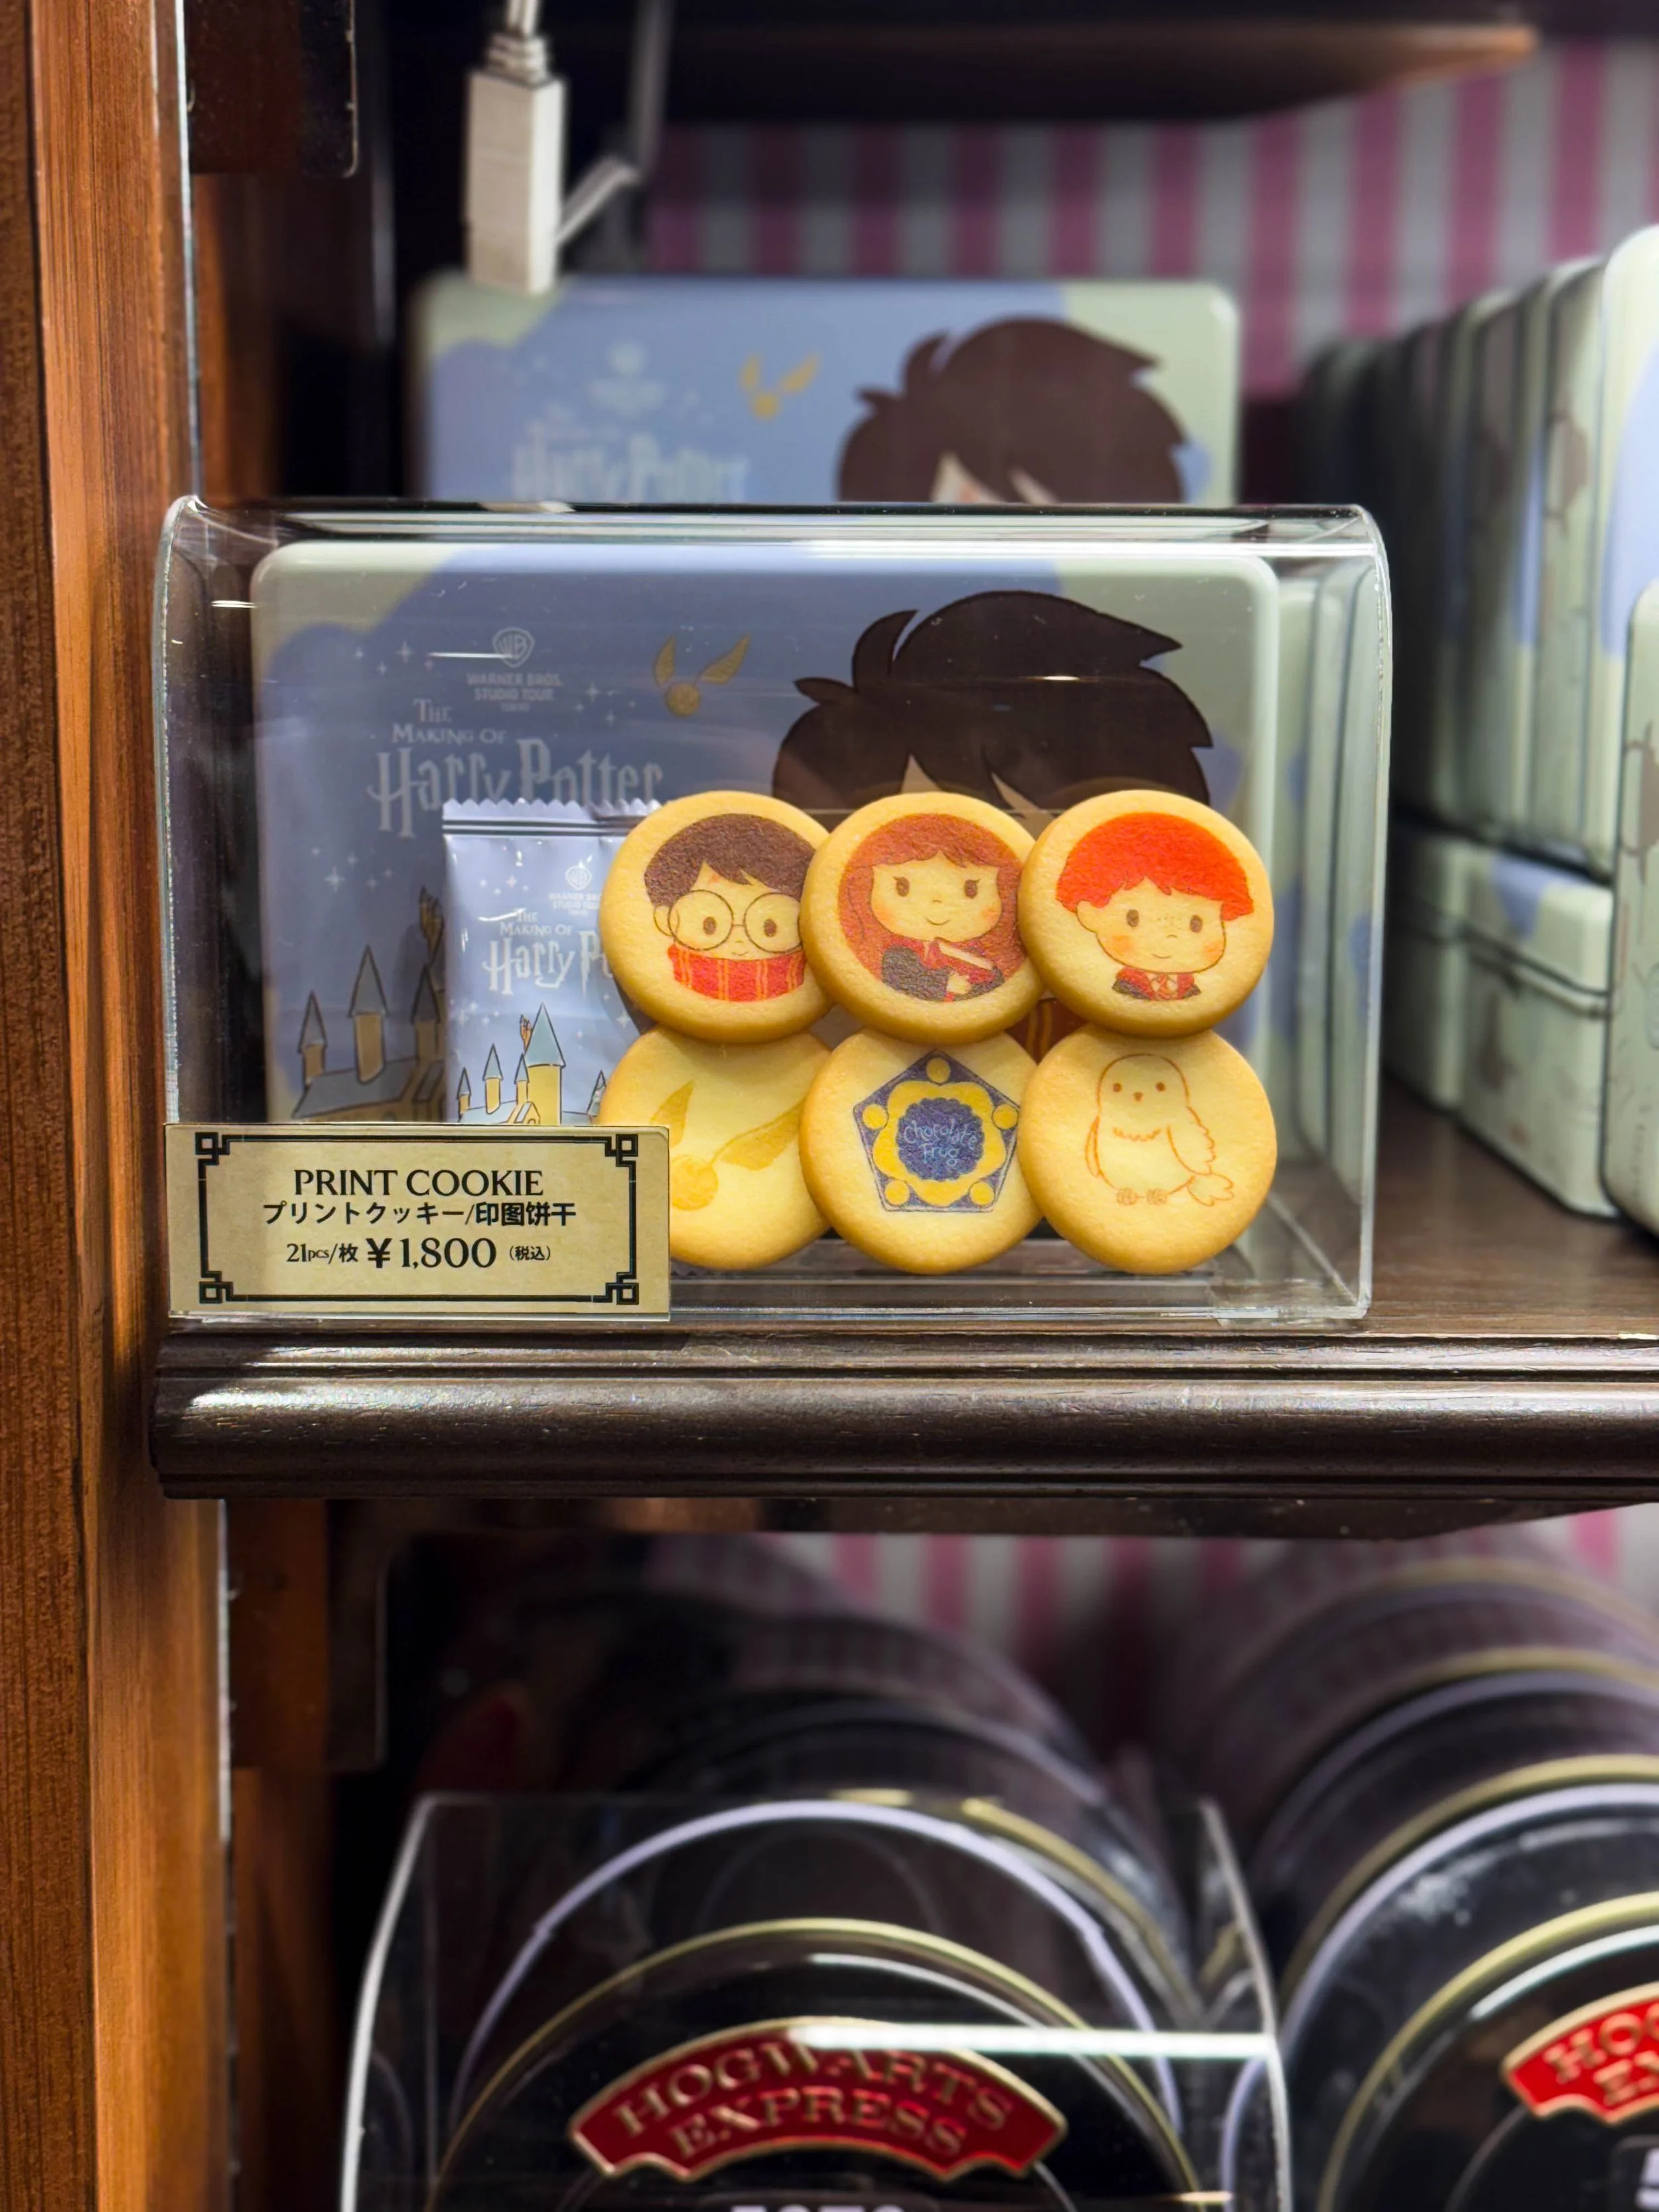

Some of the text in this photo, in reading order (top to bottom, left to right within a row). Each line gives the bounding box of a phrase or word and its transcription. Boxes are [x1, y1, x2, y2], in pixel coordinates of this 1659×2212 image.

[366, 738, 663, 839] Harry Potter
[482, 937, 575, 995] Harry
[294, 1169, 544, 1196] PRINT COOKIE
[668, 2085, 968, 2159] EXPRESS
